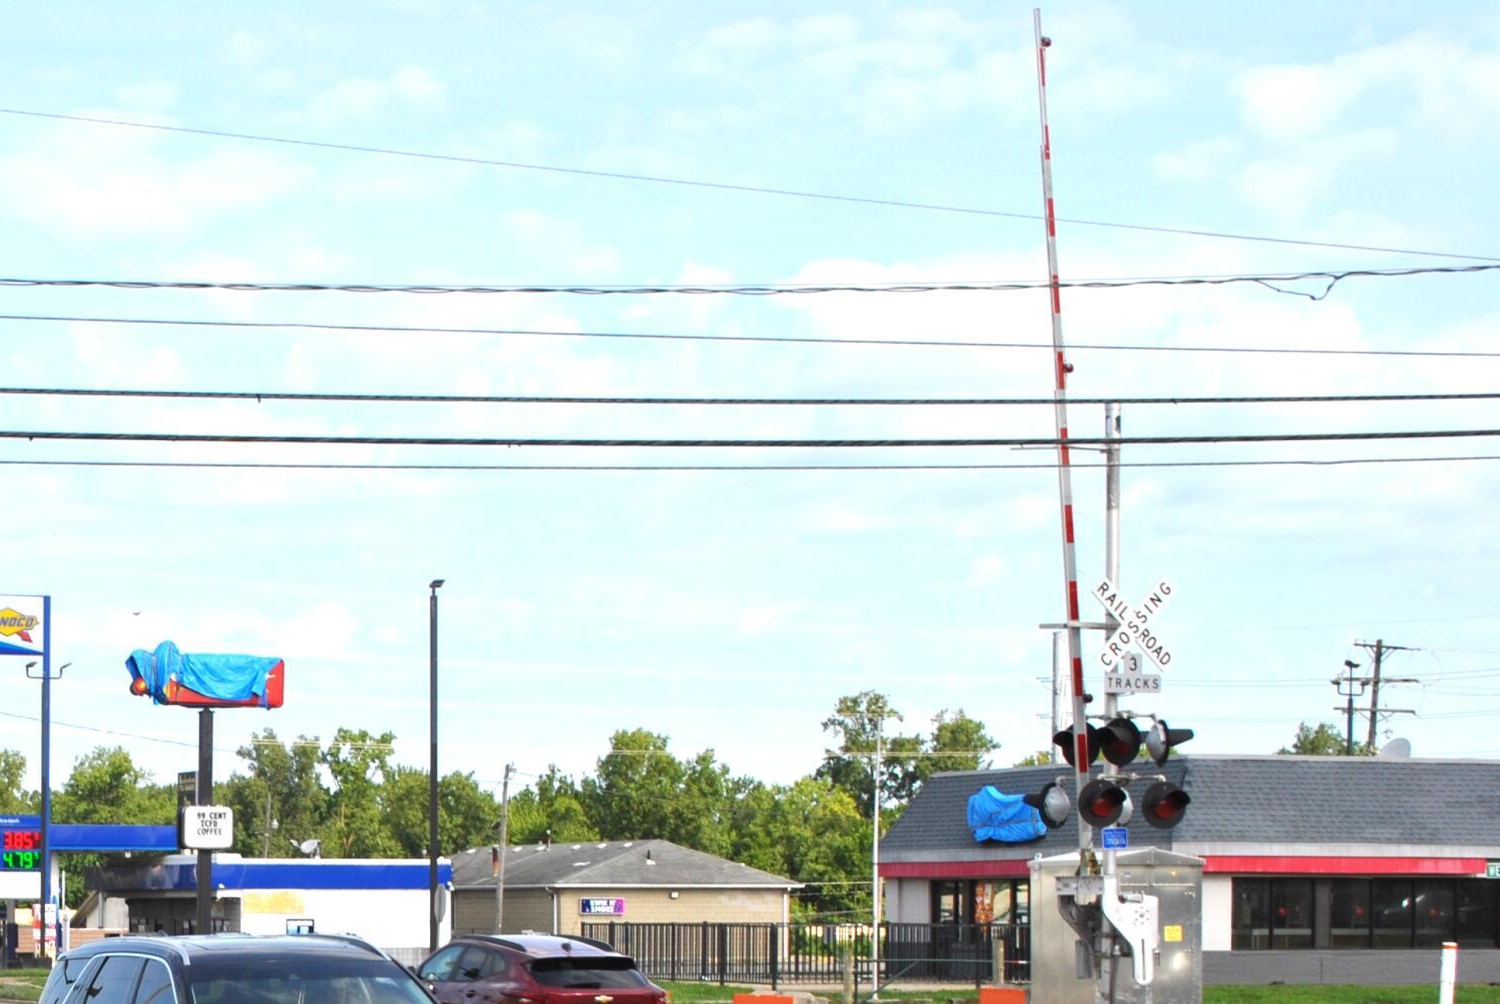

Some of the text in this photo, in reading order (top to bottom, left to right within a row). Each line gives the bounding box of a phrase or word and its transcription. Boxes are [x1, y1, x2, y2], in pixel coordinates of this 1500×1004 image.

[1100, 582, 1171, 666] CROSSING
[1128, 656, 1137, 672] 3
[1108, 677, 1159, 689] TRACKS
